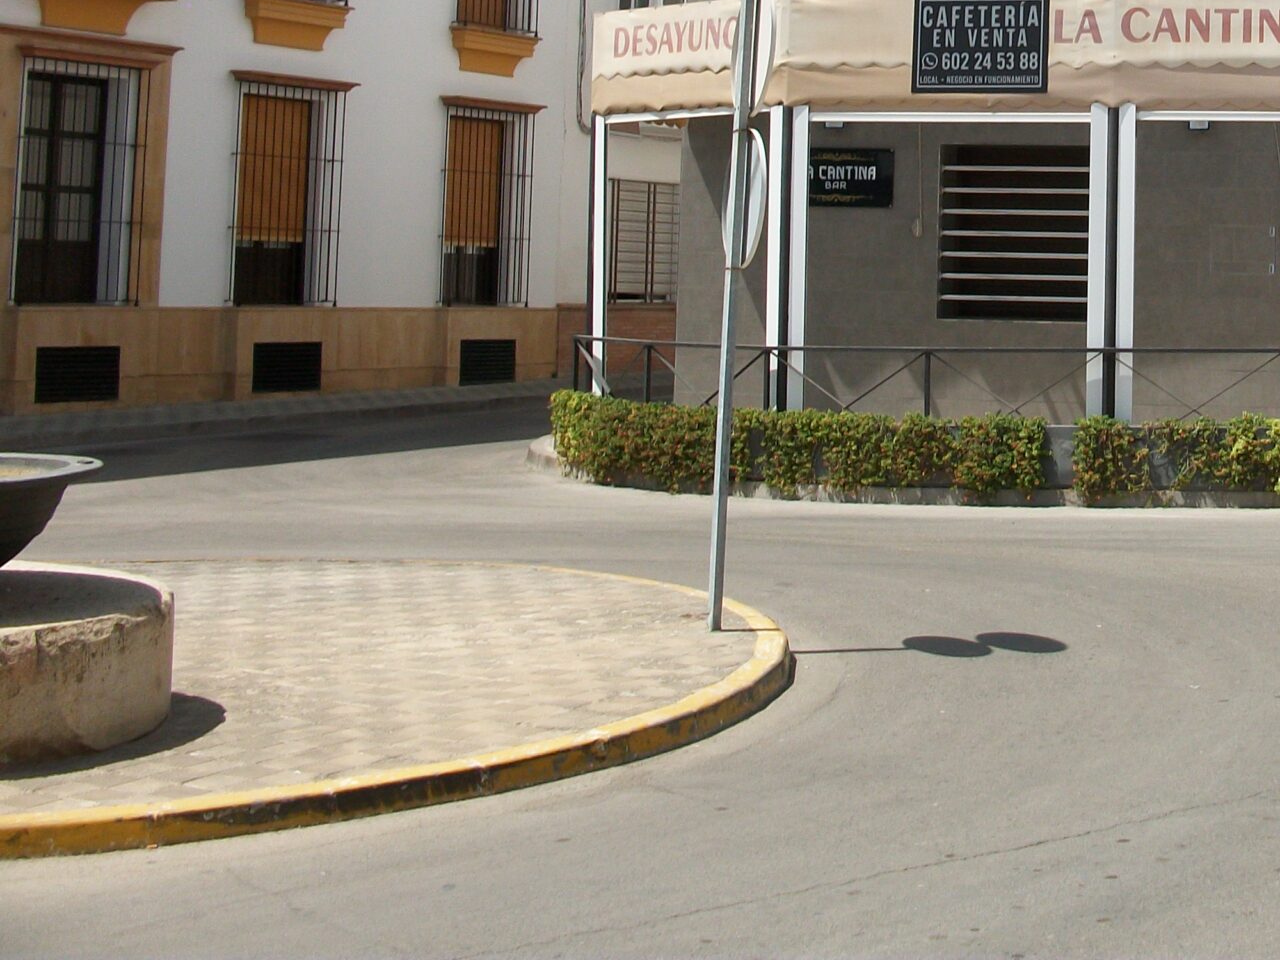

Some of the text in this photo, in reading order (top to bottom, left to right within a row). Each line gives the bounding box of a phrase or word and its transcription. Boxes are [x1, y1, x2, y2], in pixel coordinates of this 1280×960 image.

[922, 1, 1039, 28] CAFETERÍA
[1053, 9, 1103, 44] LA
[933, 28, 1028, 48] EN VENTA
[941, 52, 1039, 70] 602 24 53 88
[920, 75, 939, 84] LOCAL
[946, 75, 973, 84] NEGOCIO
[974, 75, 983, 84] EN
[984, 75, 1039, 84] FUNCIONAMIENTO
[819, 165, 876, 180] CANTINA
[825, 180, 847, 190] BAR
